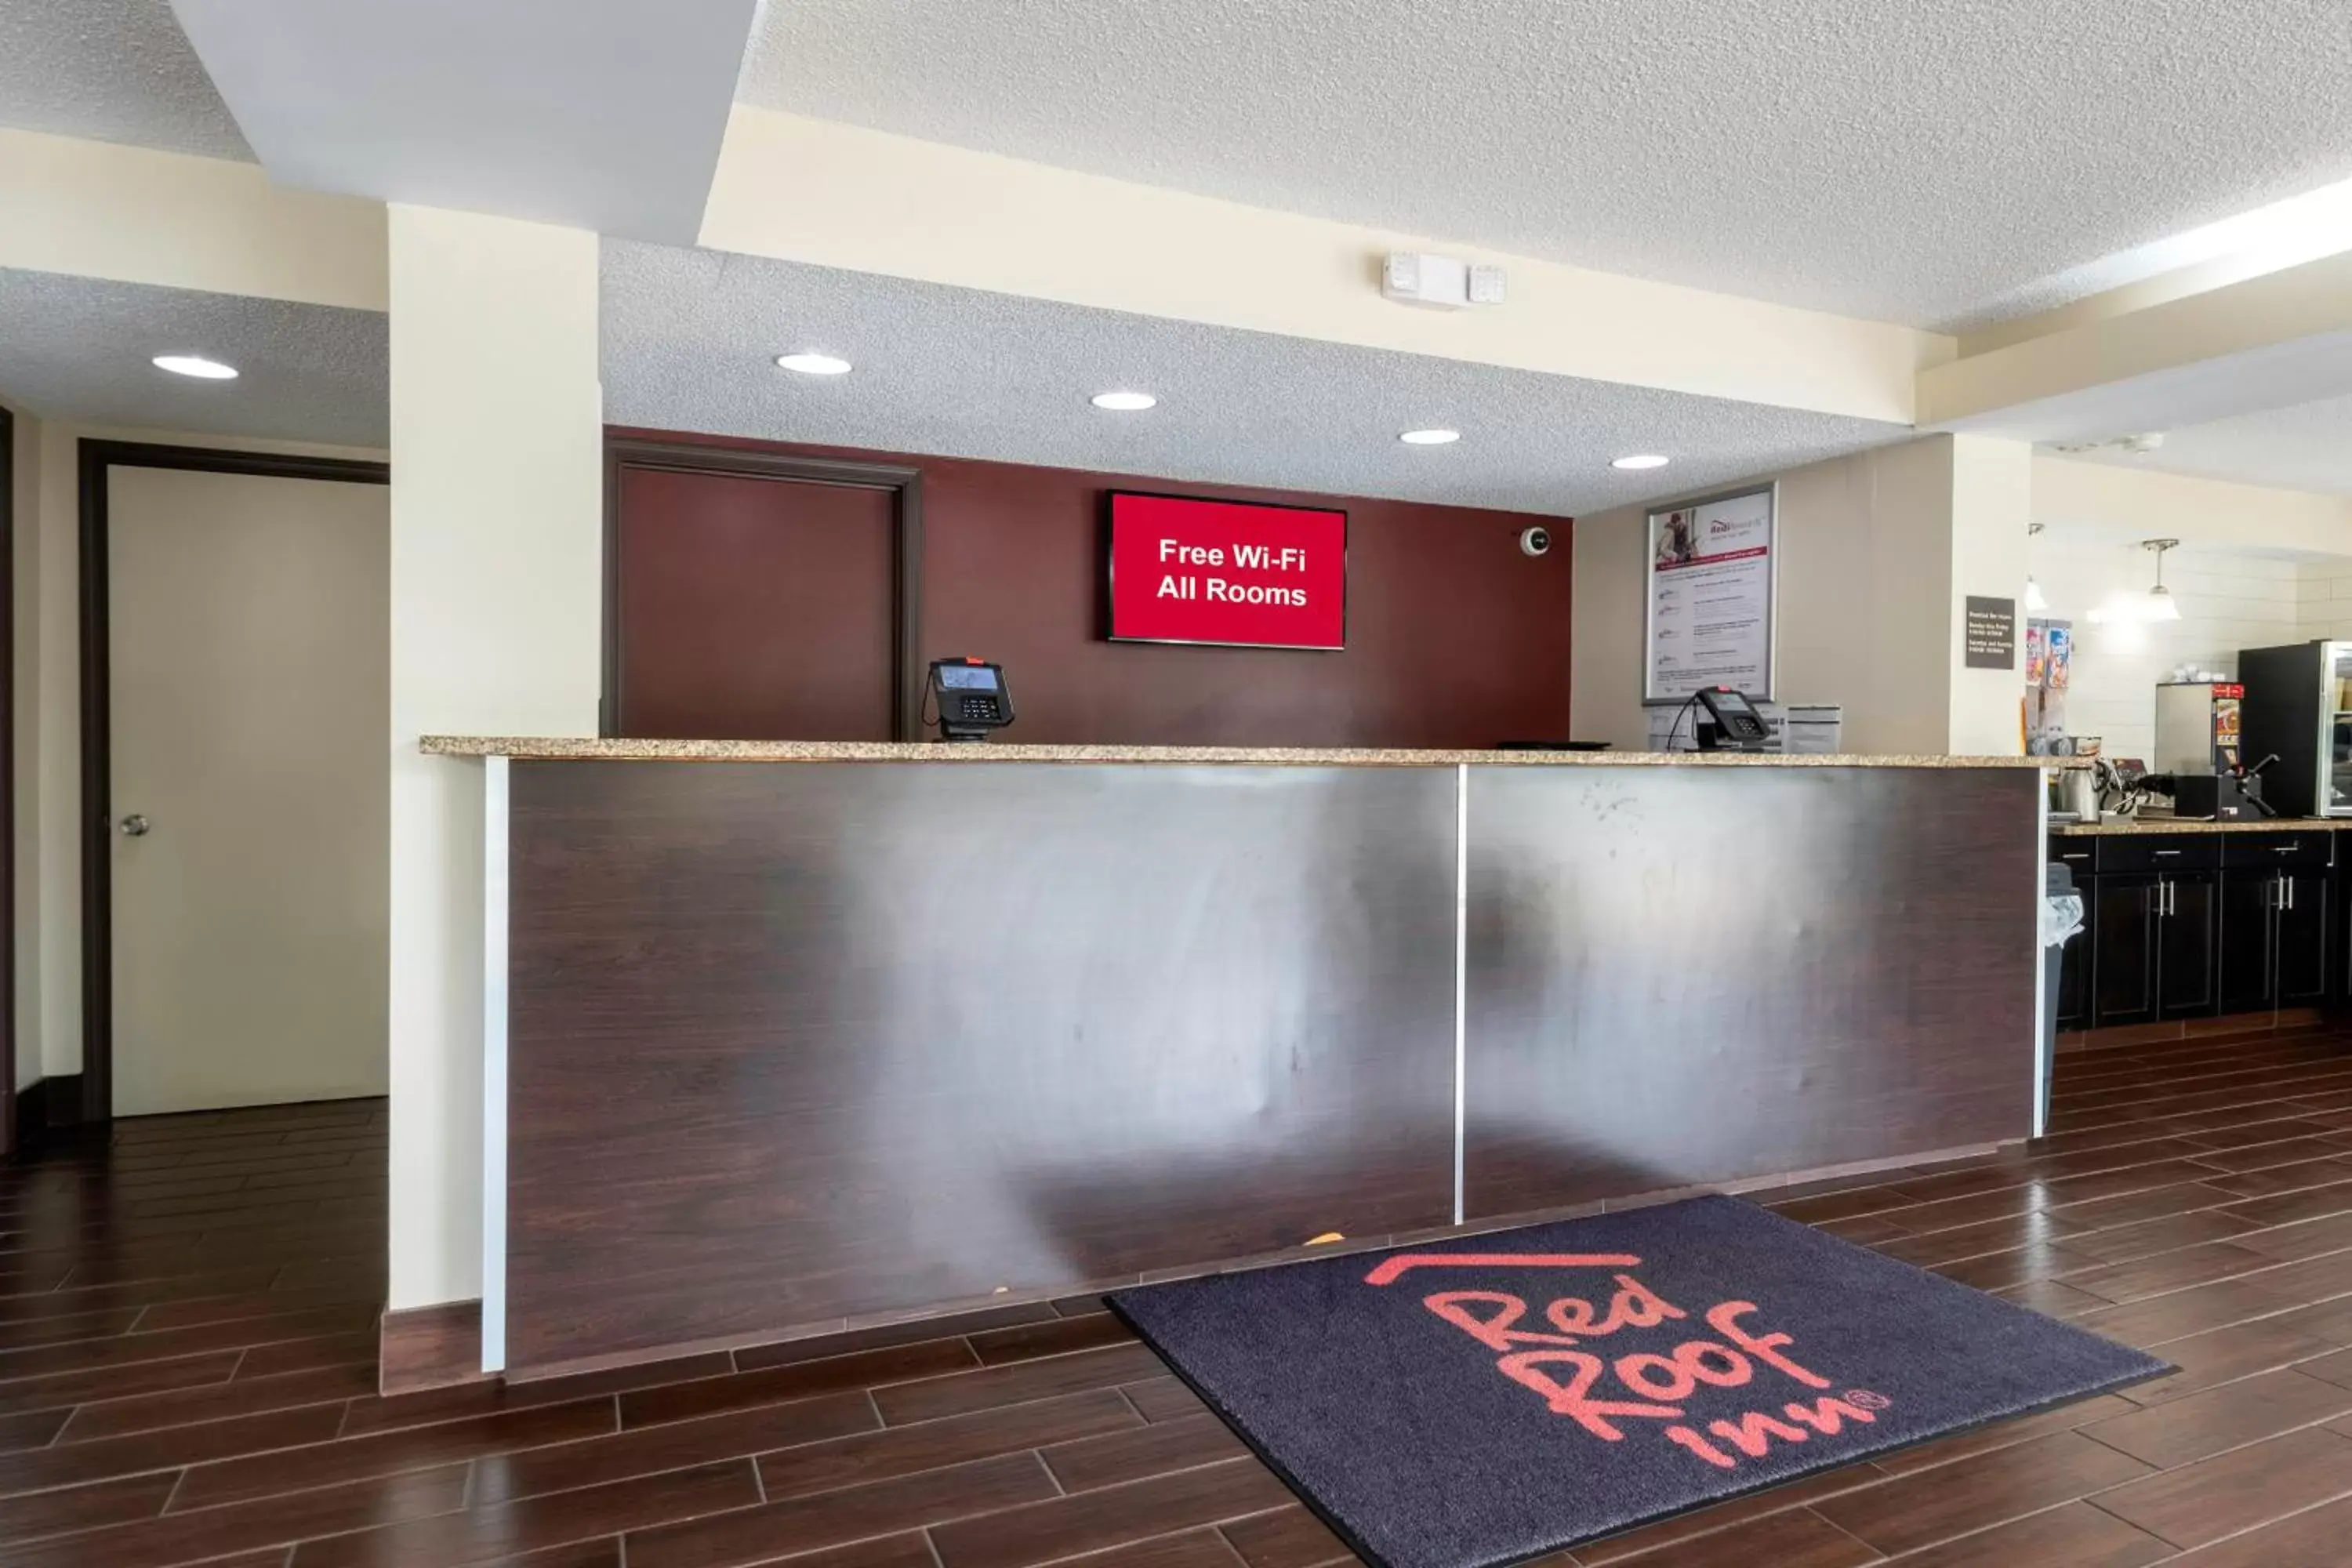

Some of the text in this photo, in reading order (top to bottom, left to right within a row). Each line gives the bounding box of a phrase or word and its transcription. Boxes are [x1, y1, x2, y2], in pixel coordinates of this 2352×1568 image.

[1160, 539, 1305, 572] Free Wi-Fi
[1156, 575, 1307, 606] All Rooms
[1422, 1273, 1687, 1352] Red
[1497, 1299, 1831, 1442] Roof
